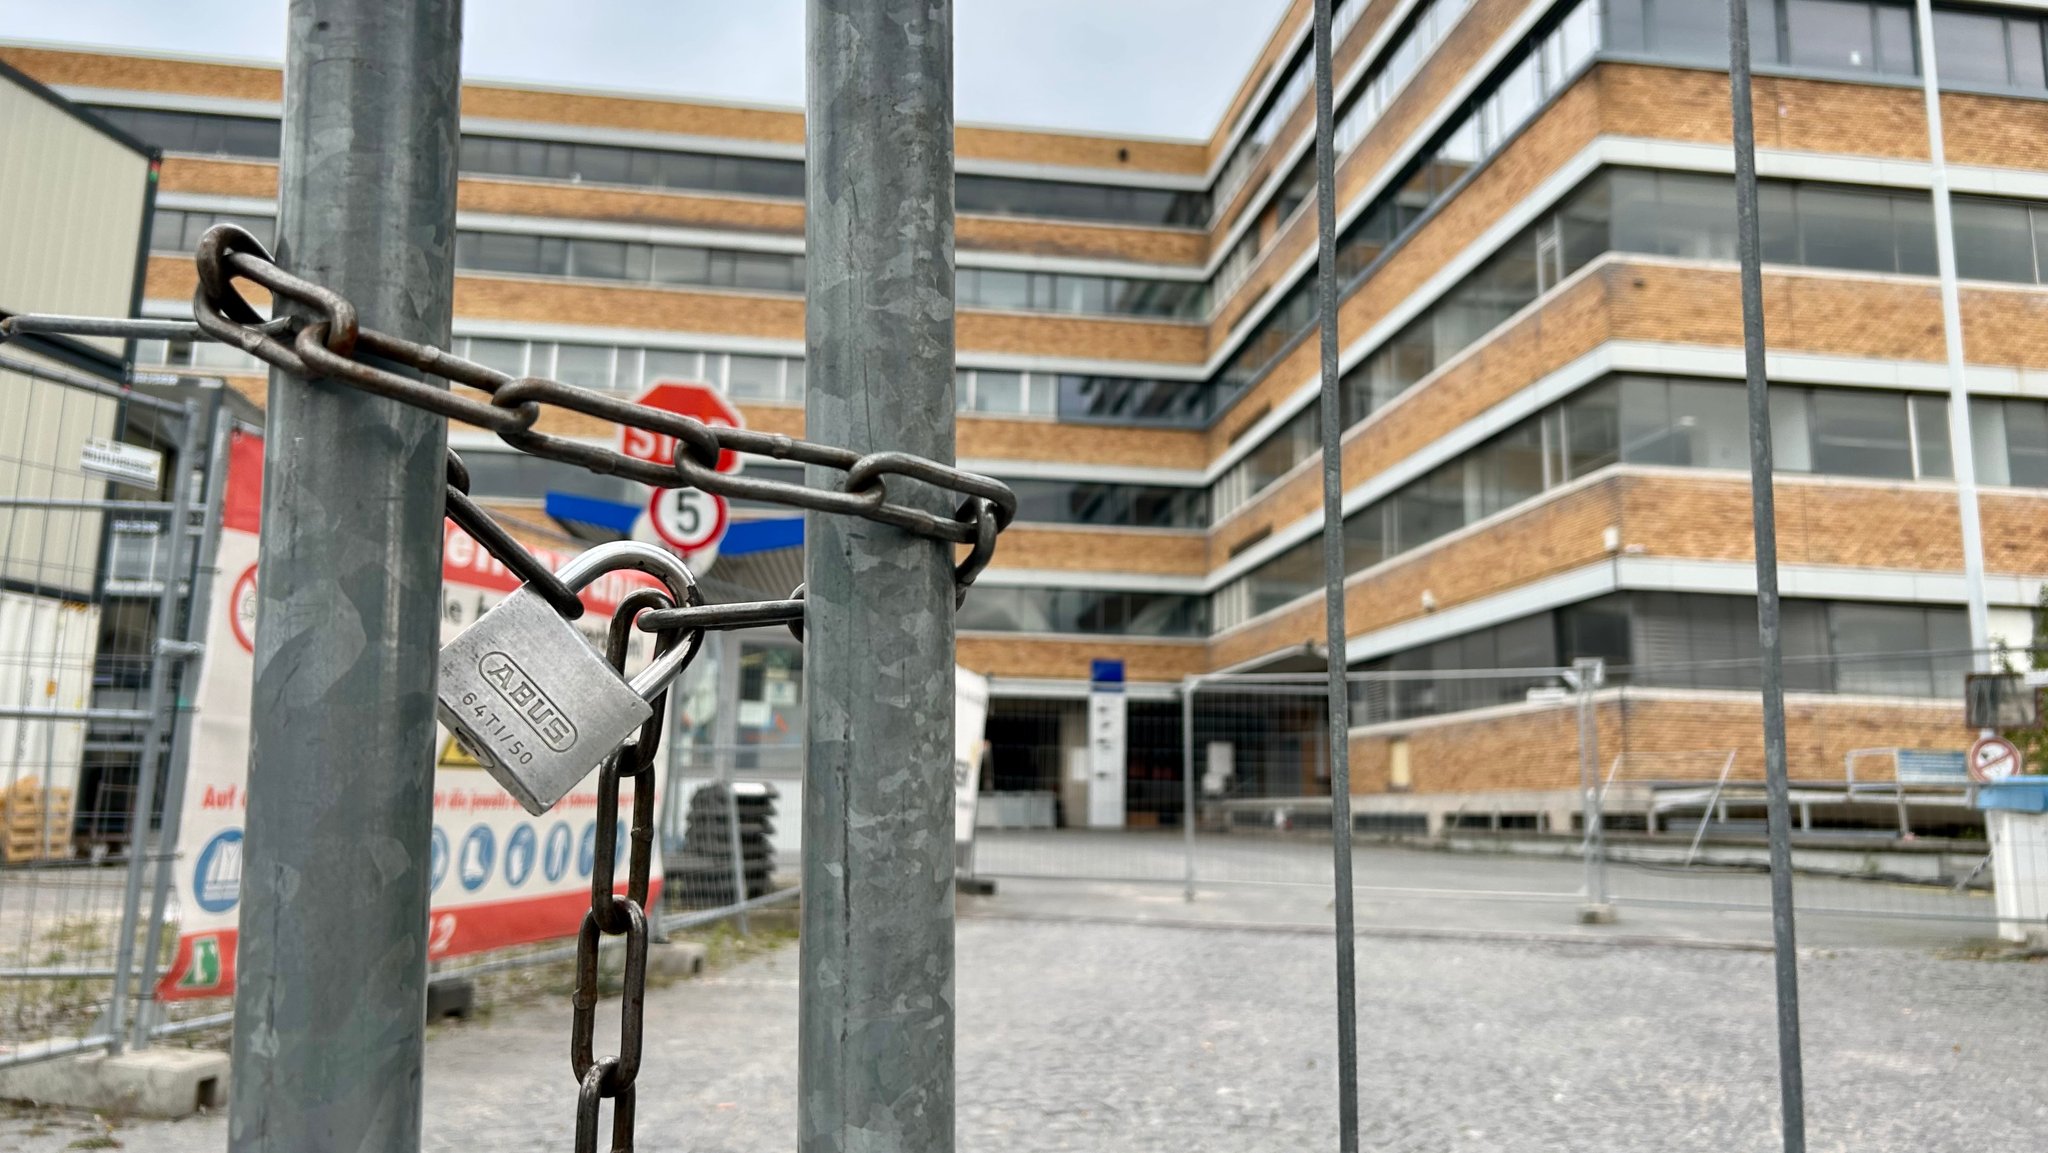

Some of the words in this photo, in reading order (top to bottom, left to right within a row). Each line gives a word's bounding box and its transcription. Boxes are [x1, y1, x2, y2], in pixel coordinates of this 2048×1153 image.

[629, 415, 727, 462] ST
[677, 490, 701, 535] 5
[487, 663, 570, 744] ABUS
[462, 692, 533, 765] 64TI/50
[202, 783, 237, 810] Auf
